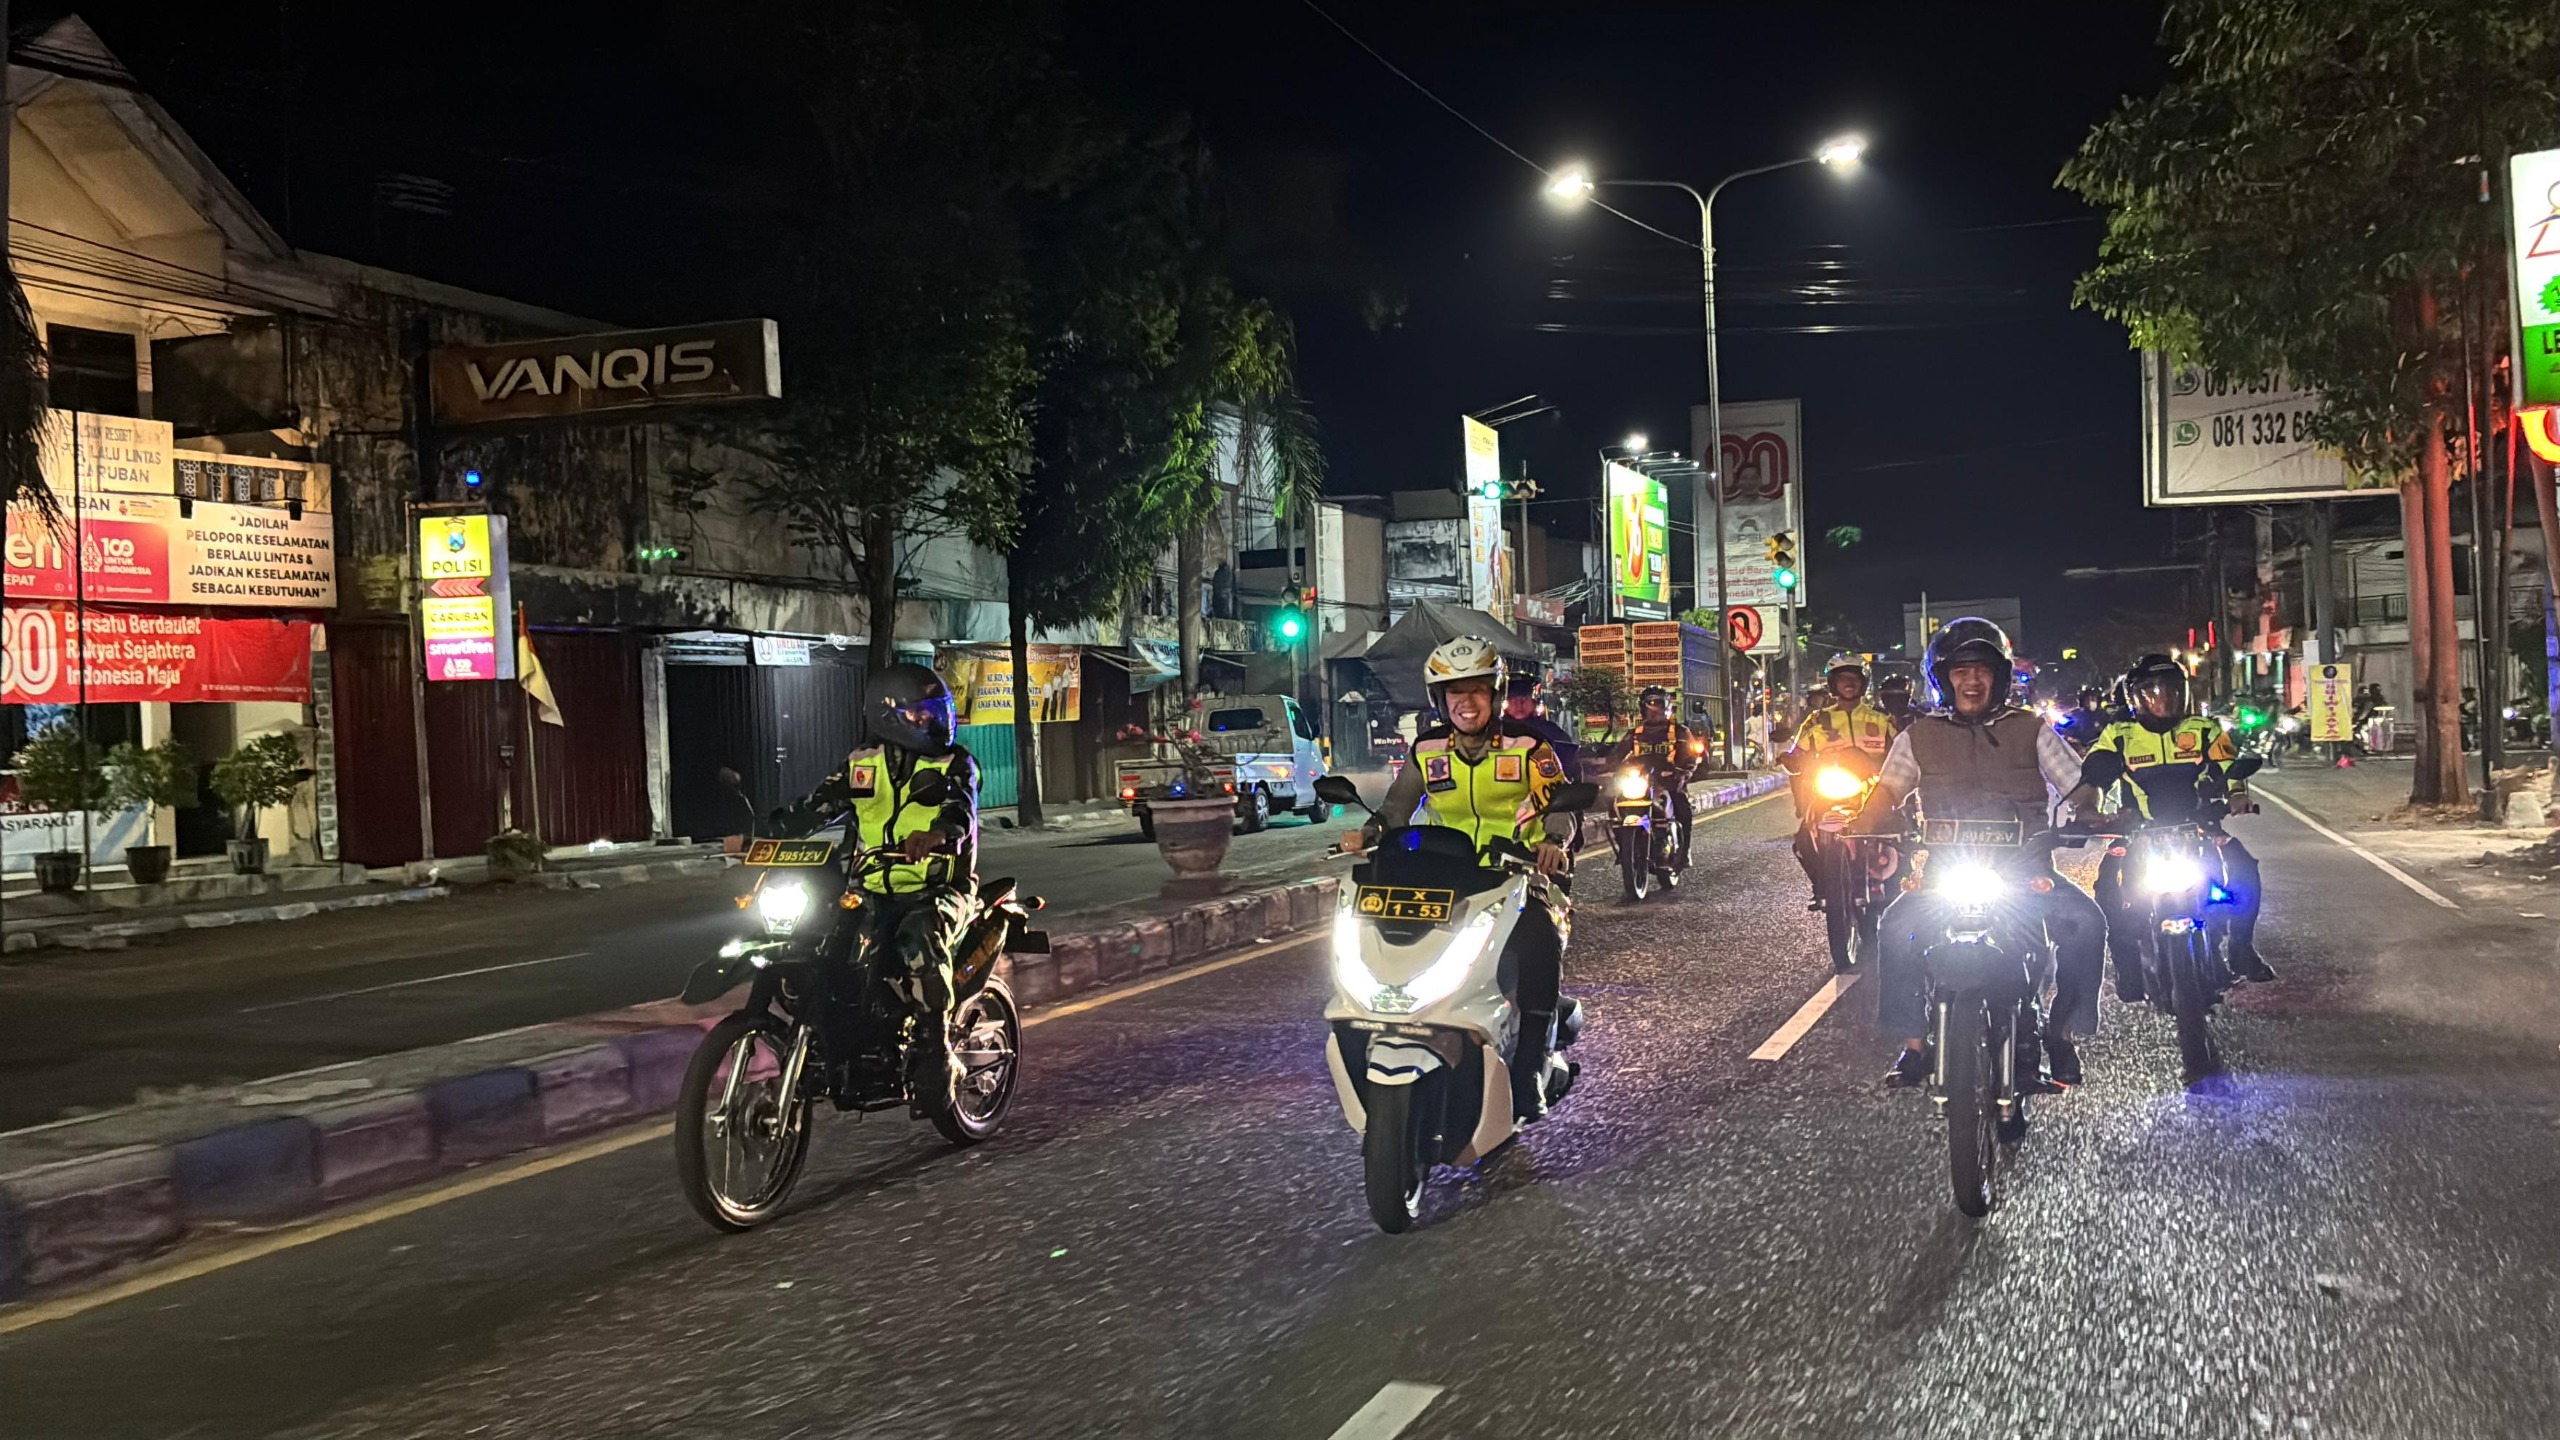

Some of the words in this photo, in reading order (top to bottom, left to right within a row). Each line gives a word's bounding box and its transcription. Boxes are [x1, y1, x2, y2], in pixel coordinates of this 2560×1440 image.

[465, 340, 715, 399] VANQIS
[2213, 415, 2245, 448] 081
[2252, 412, 2286, 445] 332
[125, 449, 162, 465] LINTAS
[186, 529, 243, 544] PELOPOR
[246, 534, 329, 549] KESELAMATAN
[104, 557, 134, 566] UNTUK
[207, 548, 262, 562] BERLALU
[264, 552, 304, 564] LINTAS
[305, 554, 313, 565] &
[104, 565, 151, 576] INDONESIA
[188, 564, 244, 578] JADIKAN
[246, 567, 330, 582] KESELAMATAN
[432, 559, 482, 573] POLISI
[192, 582, 246, 595] SEBAGAI
[129, 616, 201, 634] Berdaulat
[123, 641, 196, 664] Sejahtera
[147, 665, 180, 689] Maju
[1373, 737, 1402, 745] Wahyu
[1413, 891, 1427, 901] X
